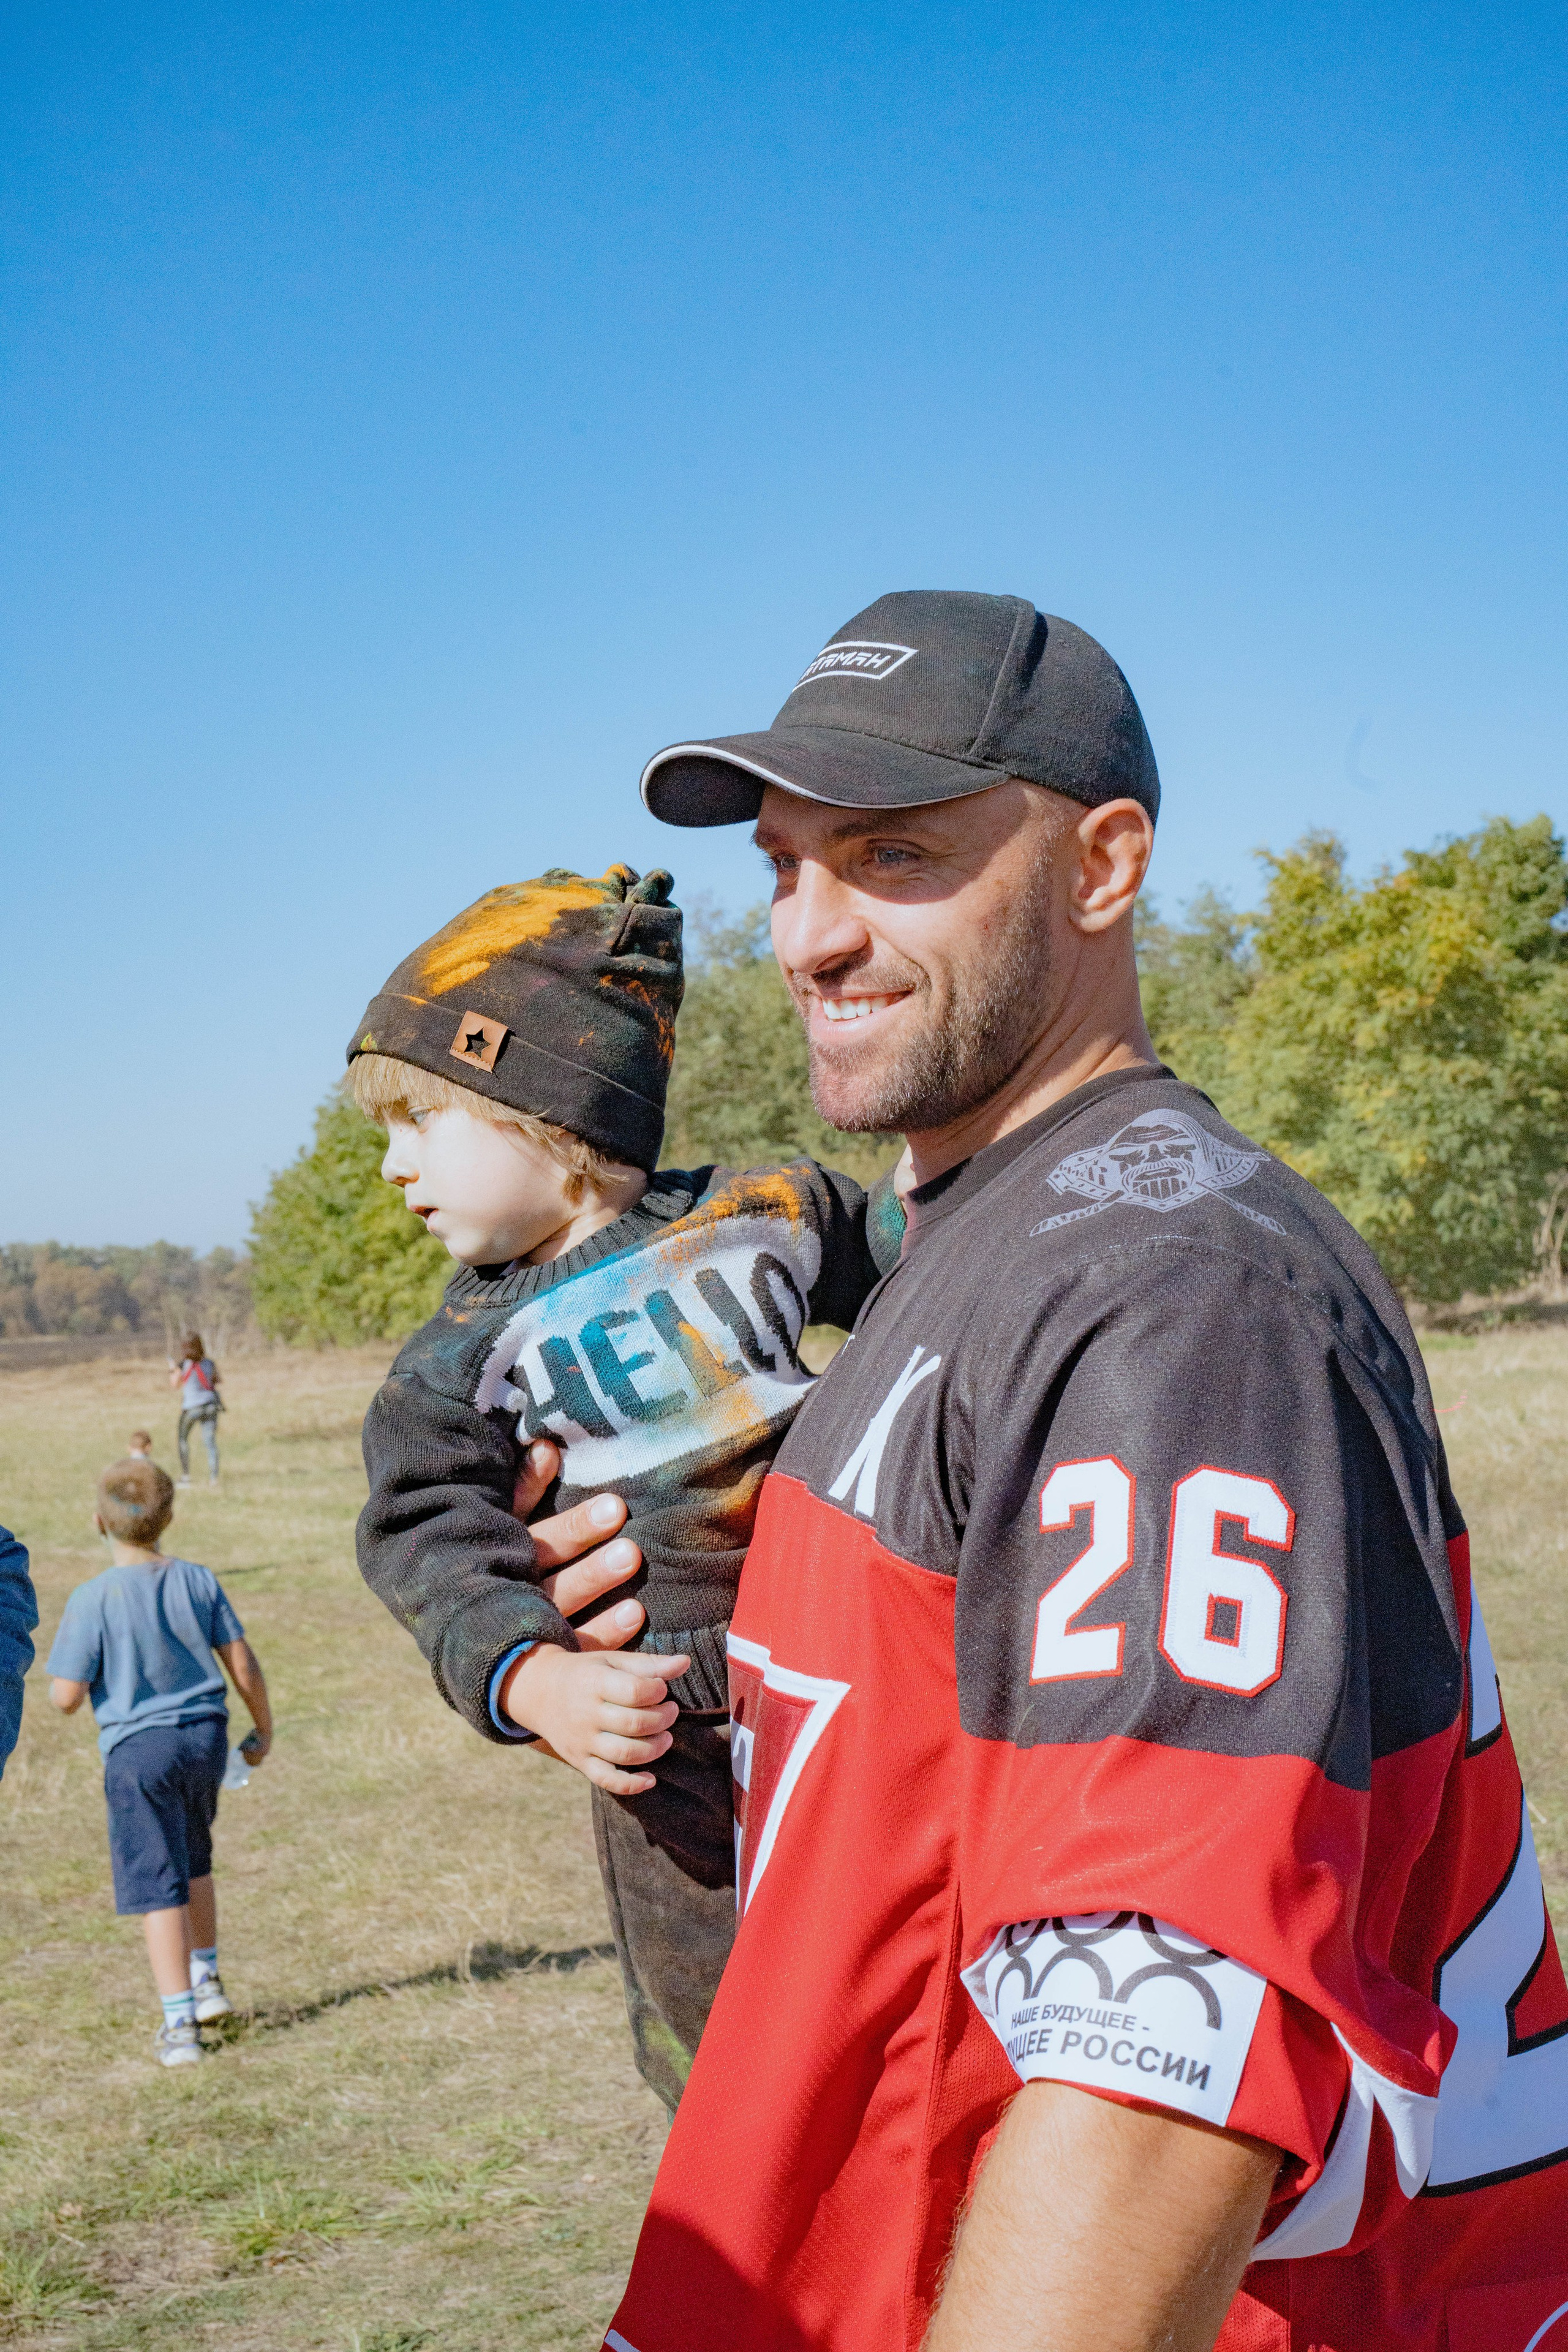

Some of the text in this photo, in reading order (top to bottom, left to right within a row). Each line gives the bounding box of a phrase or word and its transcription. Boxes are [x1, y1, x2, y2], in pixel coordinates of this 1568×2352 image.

[1028, 1453, 1297, 1698] 26
[1011, 2005, 1040, 2030] НАШЕ
[1041, 2003, 1137, 2032] БУДУЩЕЕ
[1059, 2030, 1212, 2091] РОССИИ
